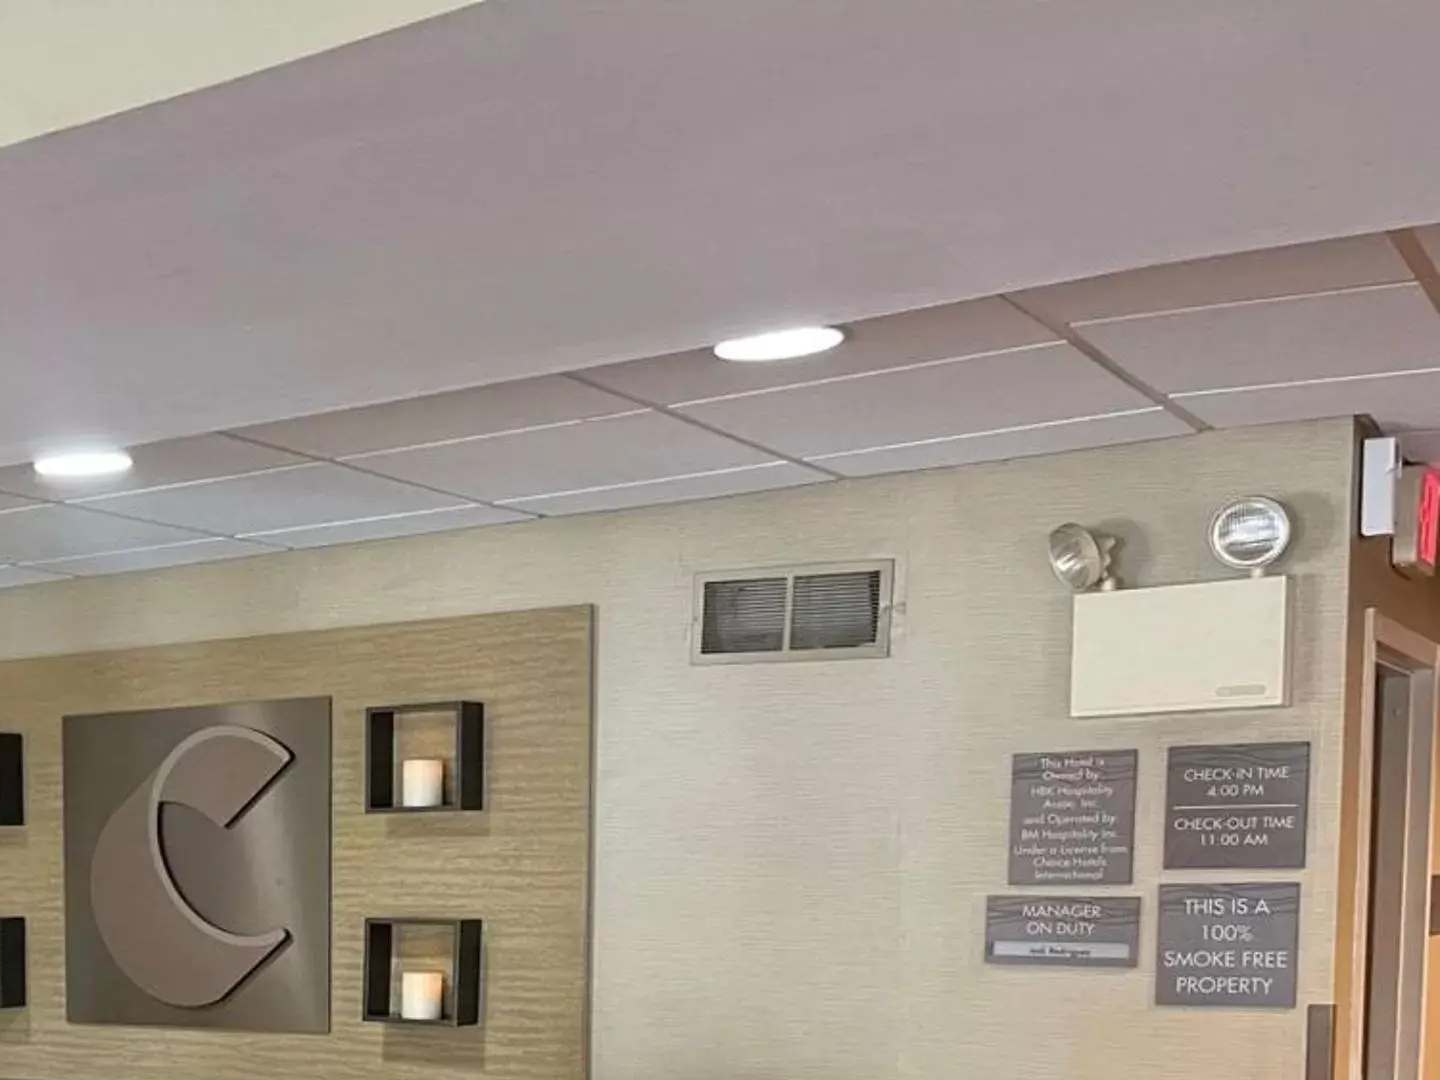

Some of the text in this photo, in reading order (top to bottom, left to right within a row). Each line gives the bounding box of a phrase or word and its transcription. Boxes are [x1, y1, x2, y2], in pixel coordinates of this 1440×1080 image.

[1085, 767, 1098, 782] by
[1259, 765, 1290, 780] TIME
[1243, 783, 1265, 796] PM
[1101, 810, 1116, 827] by
[1263, 815, 1295, 829] TIME
[1243, 833, 1269, 846] AM
[1022, 905, 1102, 918] MANAGER
[1184, 897, 1270, 915] THIS IS A
[1027, 921, 1096, 935] ON DUTY
[1202, 924, 1254, 942] 100%
[1163, 950, 1289, 969] SMOKE FREE
[1176, 976, 1273, 995] PROPERTY
